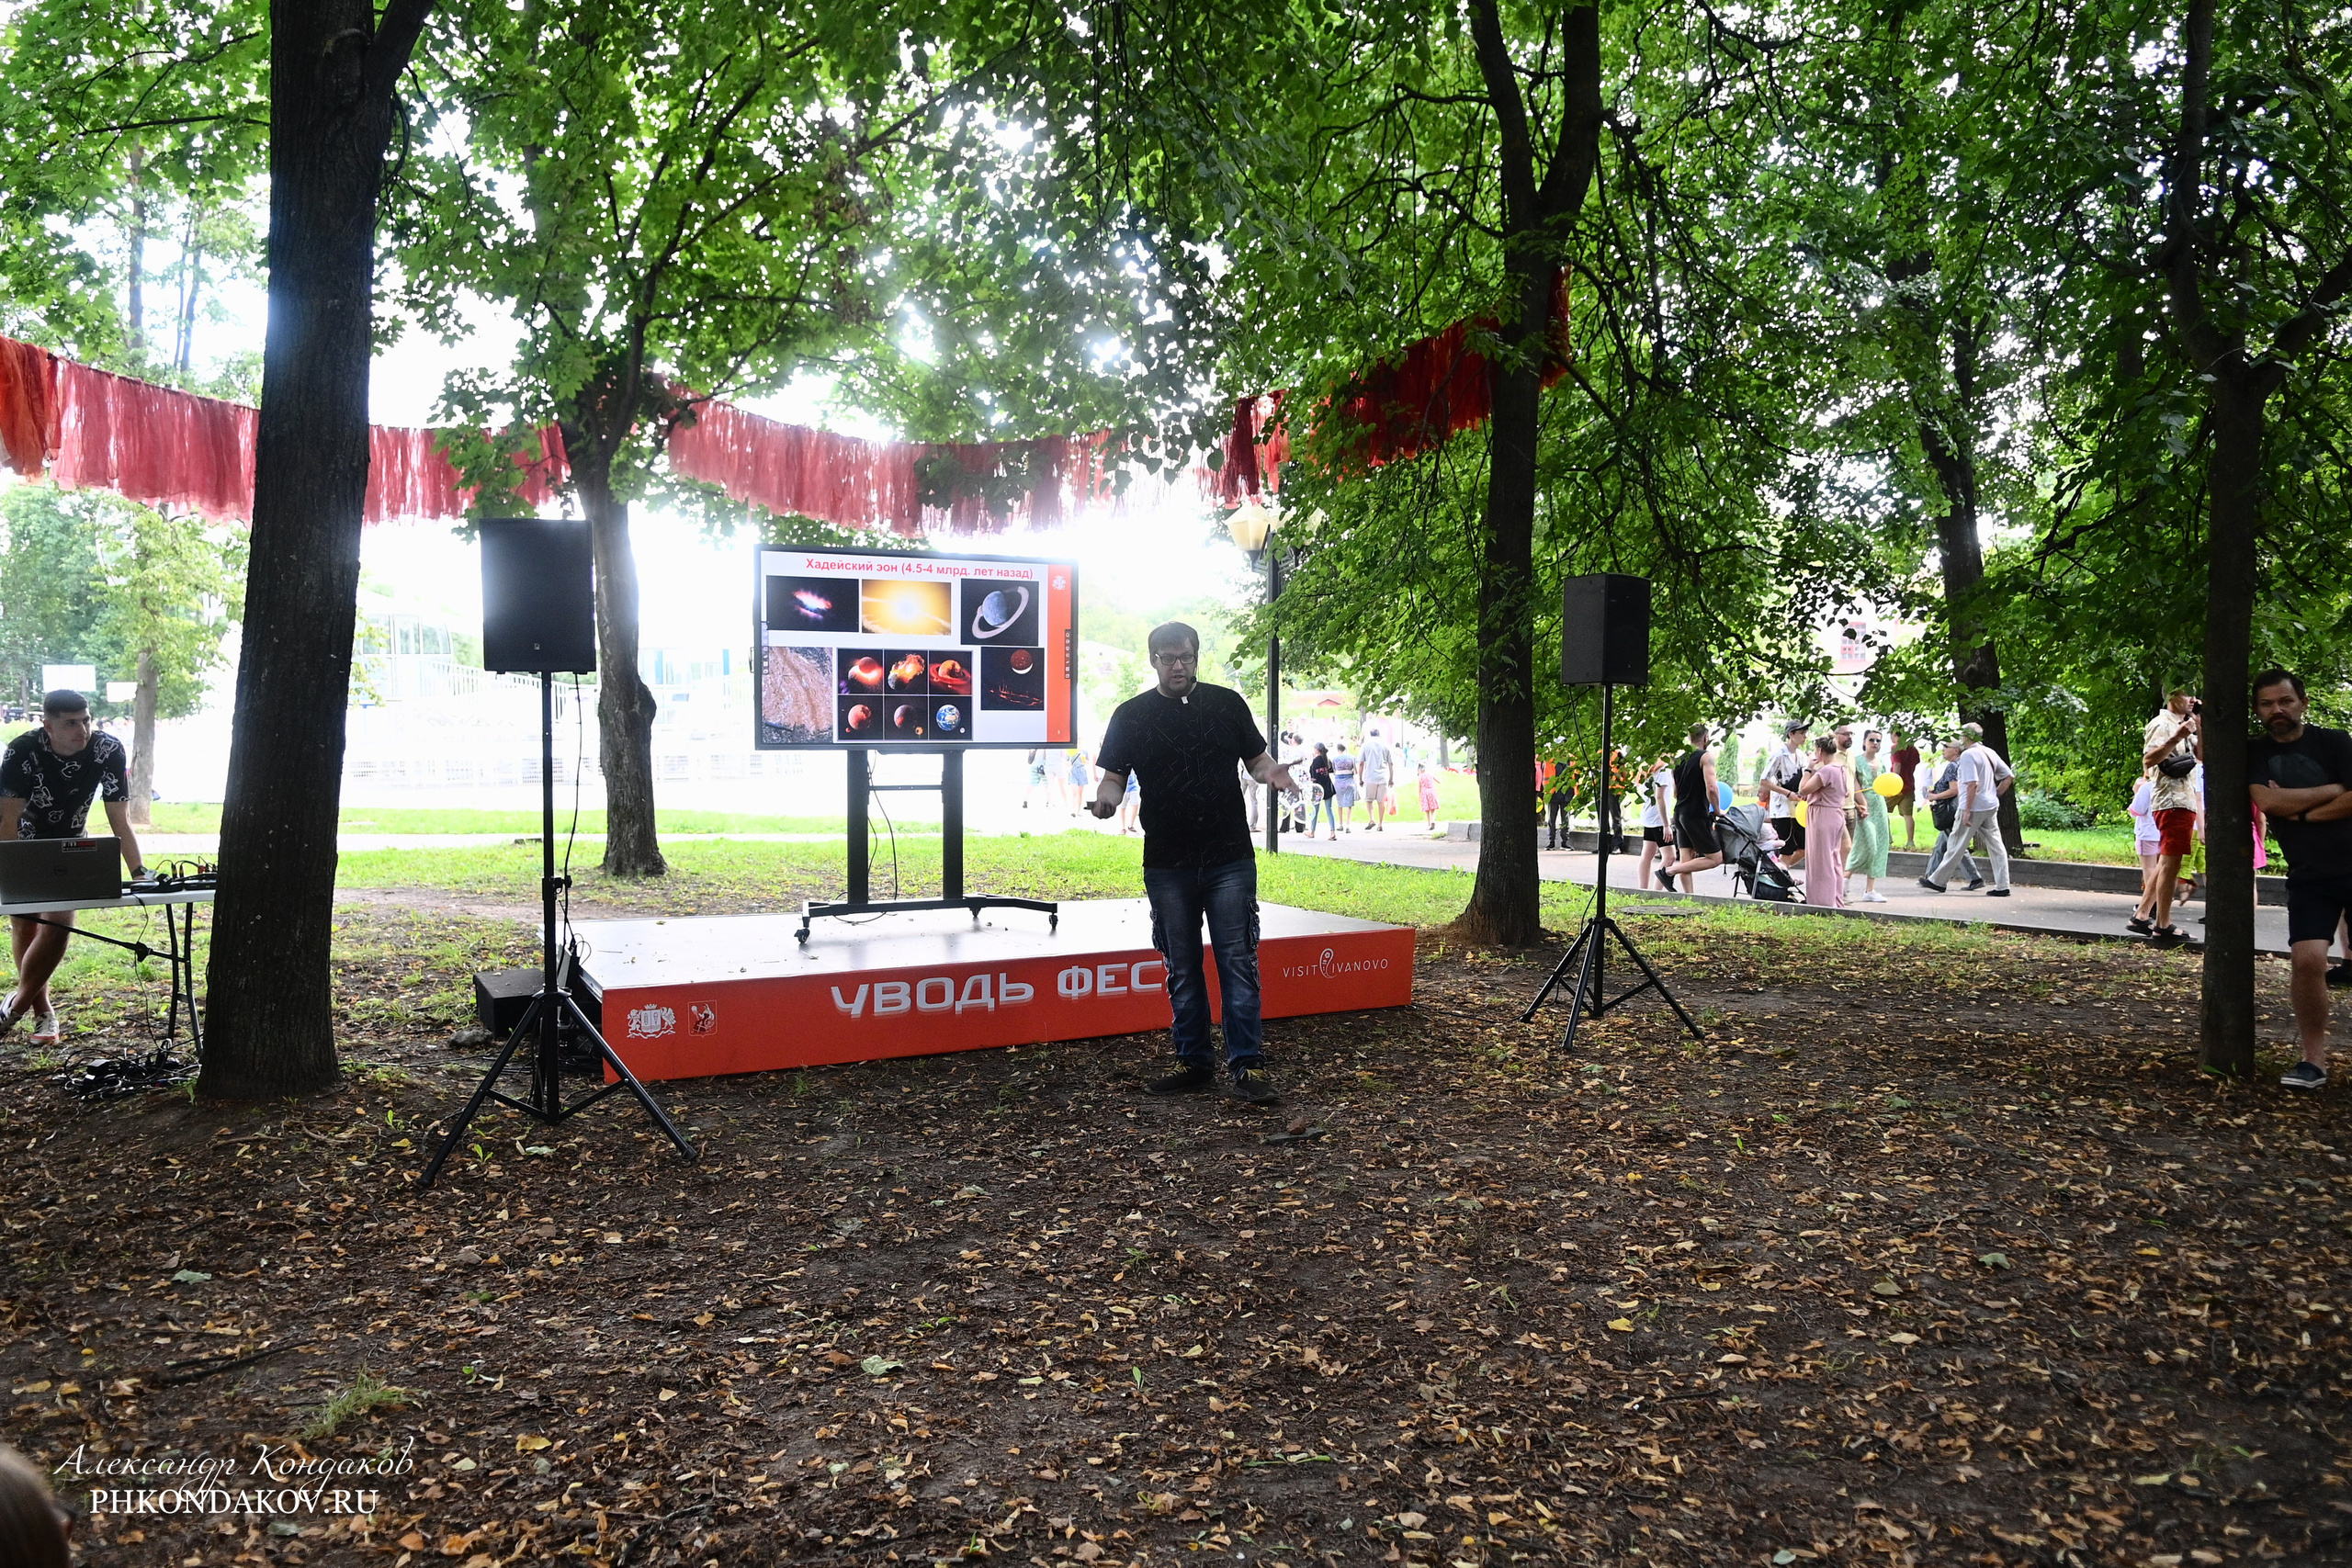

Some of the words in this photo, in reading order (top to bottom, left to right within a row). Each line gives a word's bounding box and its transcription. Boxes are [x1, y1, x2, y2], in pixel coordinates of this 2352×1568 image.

[806, 558, 874, 572] Хадейский
[876, 564, 899, 573] эон
[900, 562, 933, 575] (4.5-4
[936, 565, 970, 578] млрд.
[973, 568, 993, 578] лет
[996, 569, 1034, 581] назад)
[1283, 964, 1317, 978] VISIT
[1331, 958, 1388, 974] IVANOVO
[831, 972, 1035, 1019] УВОДЬ
[1057, 960, 1163, 1000] ФЕС
